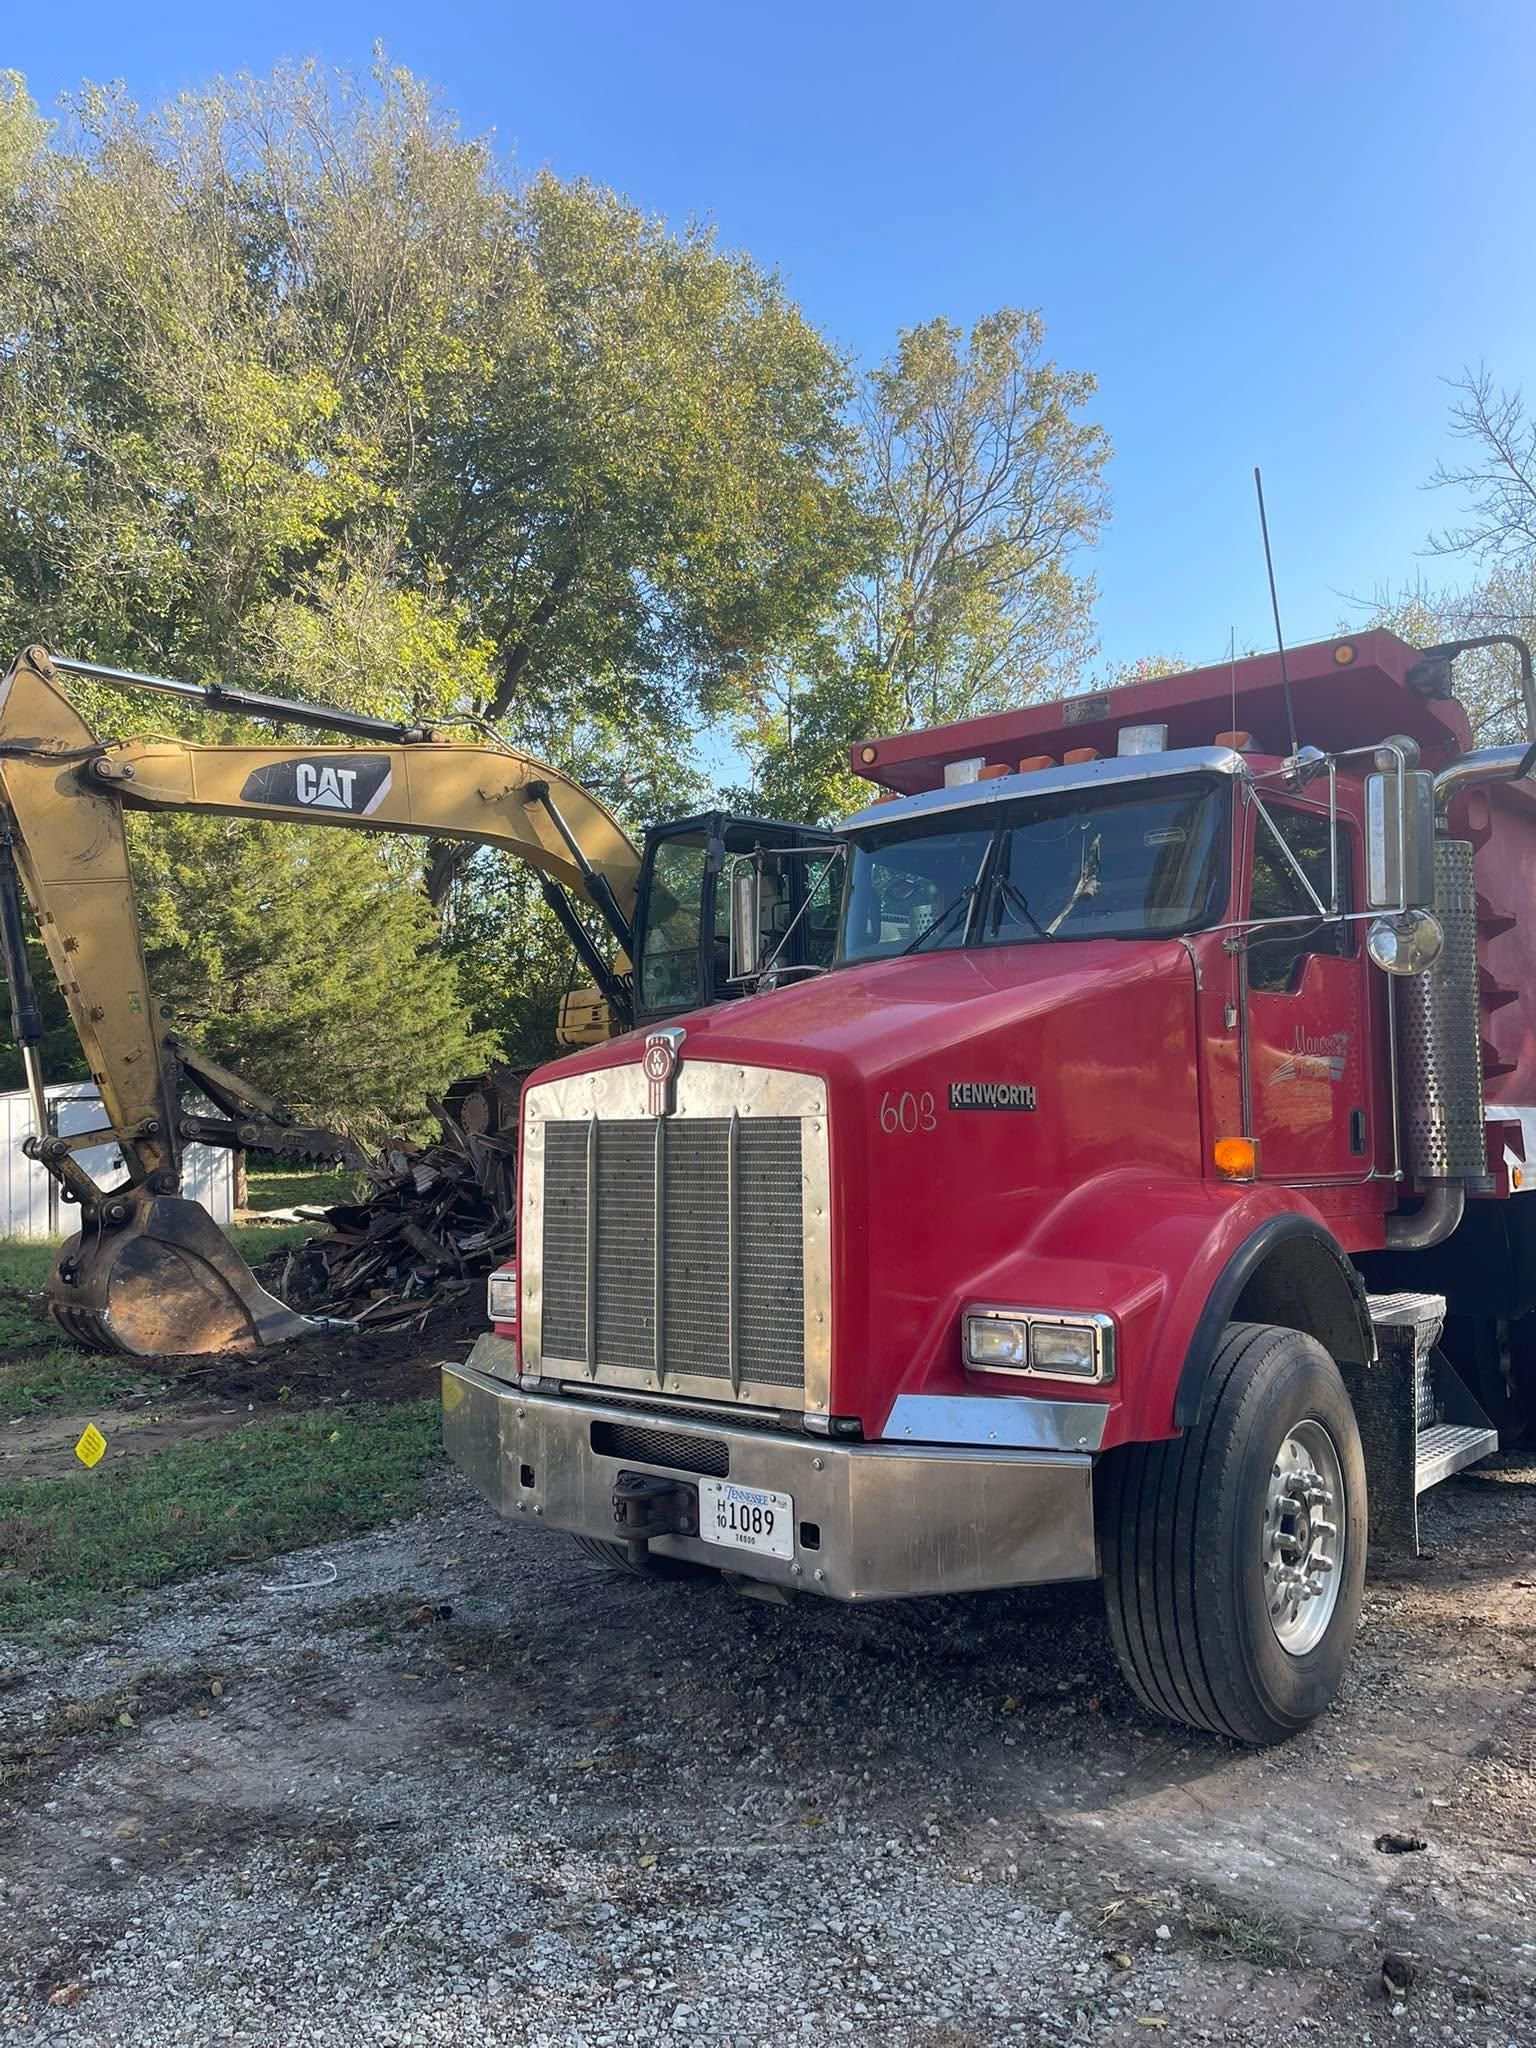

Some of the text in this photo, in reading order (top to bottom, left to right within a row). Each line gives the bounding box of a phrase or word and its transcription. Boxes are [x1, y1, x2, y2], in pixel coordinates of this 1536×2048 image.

[296, 763, 357, 809] CAT
[951, 1083, 1037, 1105] KENWORTH
[880, 1091, 937, 1133] 603
[717, 1499, 726, 1512] H
[724, 1485, 769, 1506] TENNESSEE
[716, 1514, 727, 1528] 10
[729, 1502, 774, 1536] 1089
